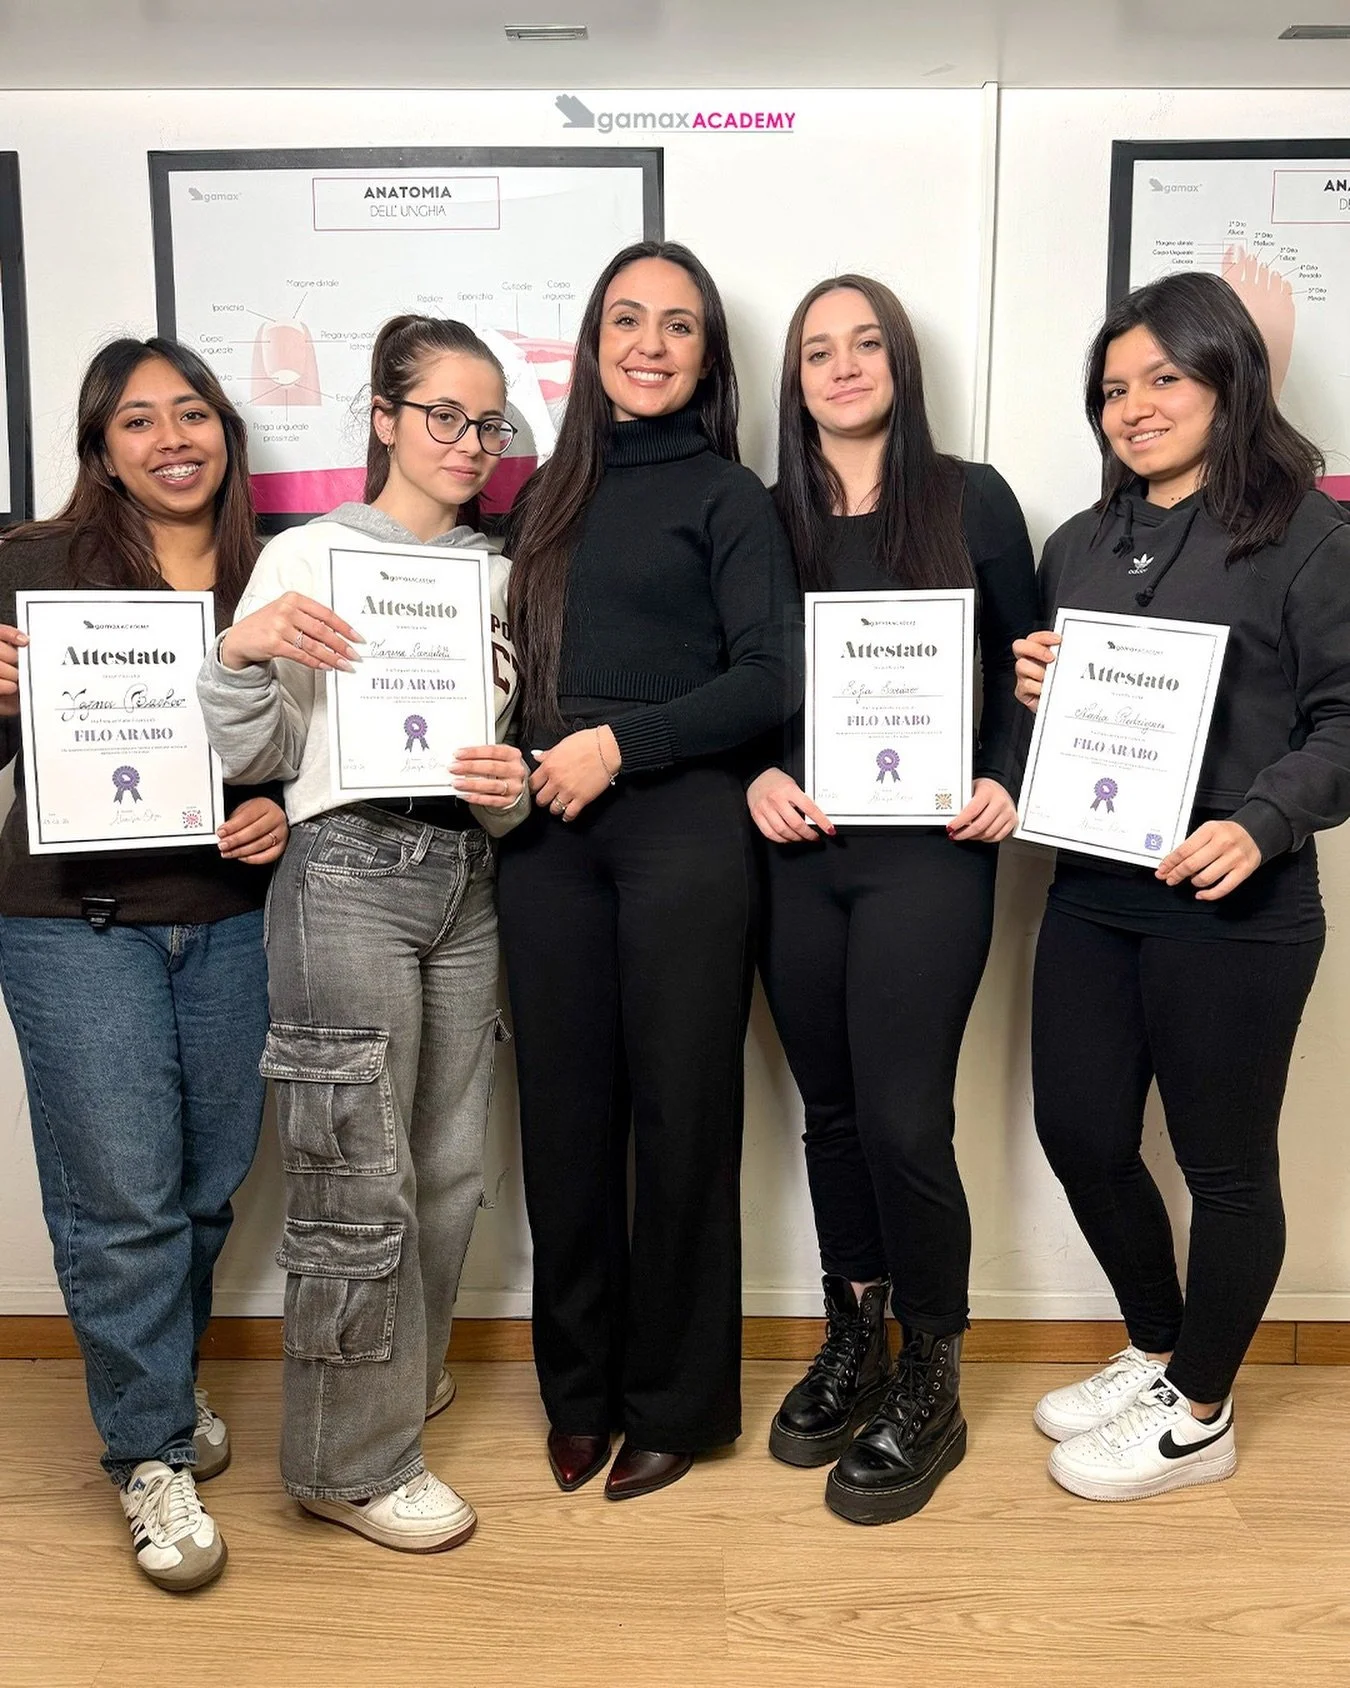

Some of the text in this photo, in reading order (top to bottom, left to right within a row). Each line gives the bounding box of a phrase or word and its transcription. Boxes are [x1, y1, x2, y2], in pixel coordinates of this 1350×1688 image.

[364, 186, 452, 199] ANATOMIA
[1324, 179, 1350, 191] AN
[400, 205, 447, 217] UNGHIA
[361, 595, 458, 619] Attestato
[61, 646, 176, 665] Attestato
[840, 641, 938, 659] Attestato
[371, 678, 456, 691] FILO ARABO
[1080, 662, 1180, 692] Attestato
[847, 715, 931, 727] FILO ARABO
[74, 727, 174, 743] FILO ARABO
[1072, 737, 1158, 761] FILO ARABO
